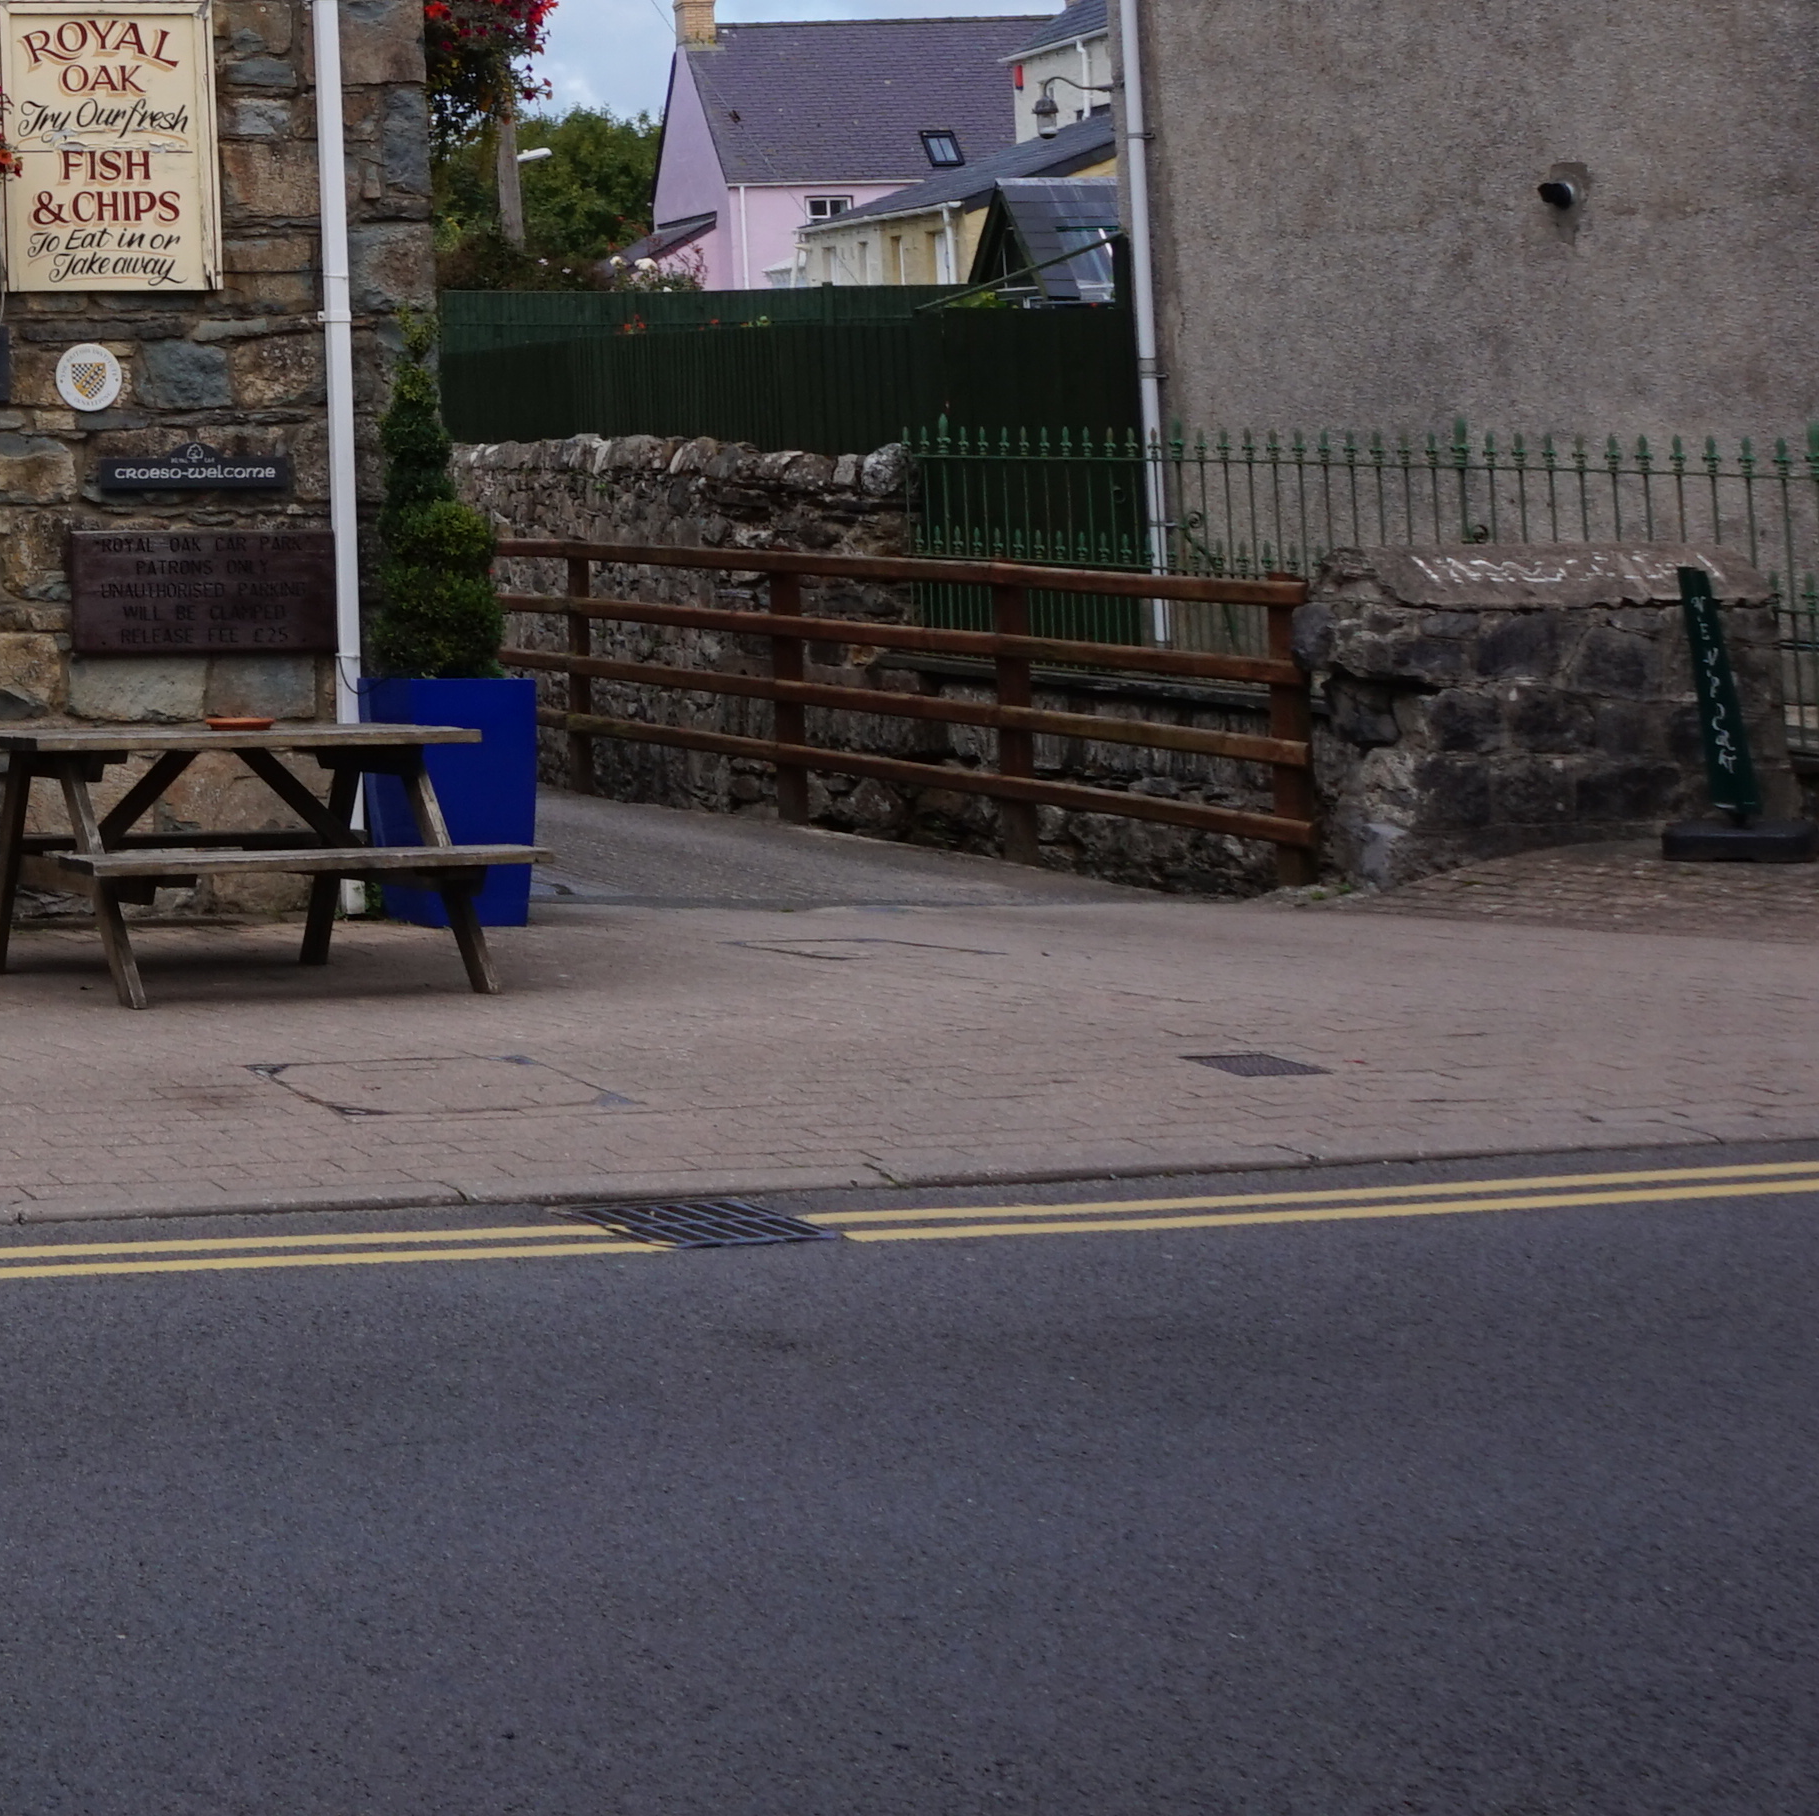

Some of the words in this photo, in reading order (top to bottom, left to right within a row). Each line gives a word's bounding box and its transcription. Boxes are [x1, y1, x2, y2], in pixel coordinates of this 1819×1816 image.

[20, 20, 180, 71] ROYAL
[60, 64, 146, 96] OAK
[18, 100, 71, 143] Try
[76, 98, 126, 129] Our
[118, 98, 188, 138] fresh
[60, 150, 151, 182] FISH
[72, 191, 181, 224] CHIPS
[27, 232, 60, 257] To
[66, 228, 113, 250] Eat
[117, 228, 146, 249] in
[150, 233, 180, 250] or
[170, 537, 202, 552] OAK
[215, 536, 247, 552] CAR
[136, 560, 212, 575] PATRONS
[227, 559, 269, 575] ONLY
[100, 582, 224, 599] UNAUTHORISED
[238, 582, 307, 598] PARKING
[123, 605, 162, 621] WILL
[177, 605, 195, 621] BE
[210, 604, 286, 621] CLAMPED
[121, 628, 194, 644] RELEASE
[208, 627, 239, 644] FEE
[253, 627, 289, 643] £25
